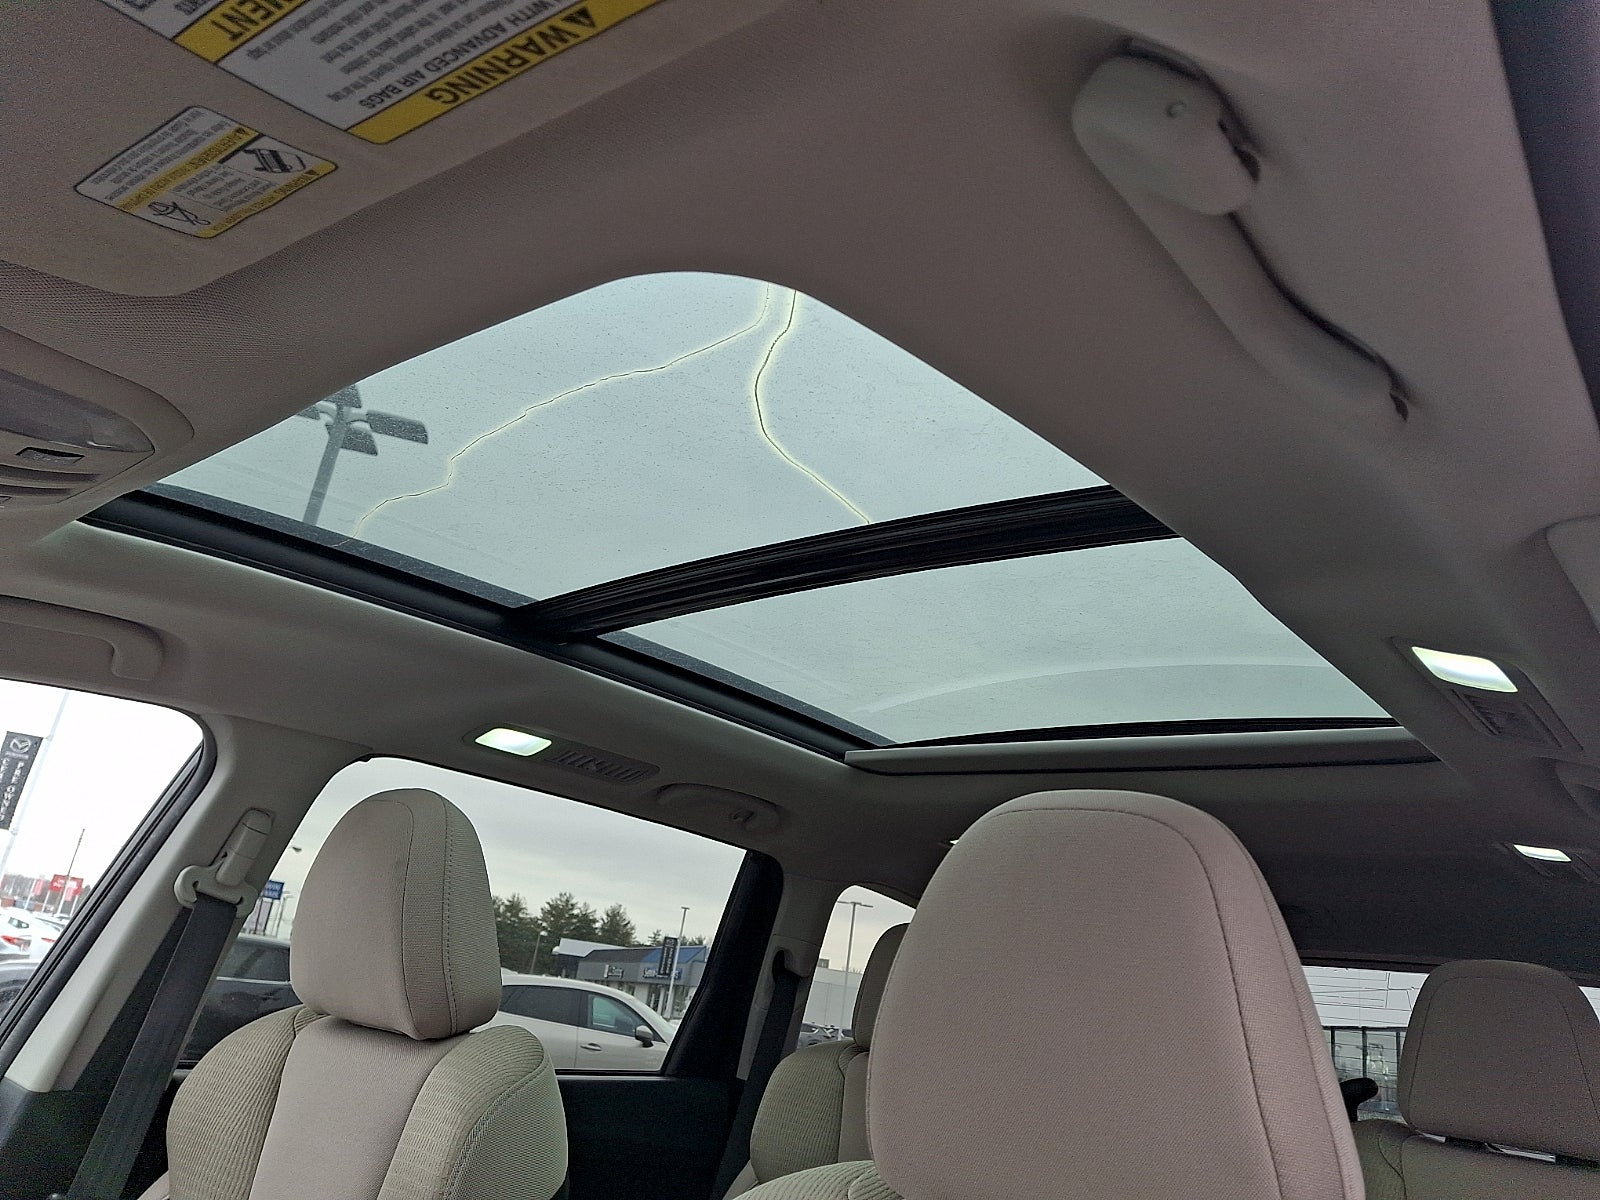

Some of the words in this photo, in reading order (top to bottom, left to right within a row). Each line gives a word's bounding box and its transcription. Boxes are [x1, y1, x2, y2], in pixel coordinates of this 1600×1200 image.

[424, 21, 507, 73] ADVANCED
[425, 24, 581, 106] WARNING
[358, 84, 403, 109] BAGS
[398, 69, 426, 88] AIR
